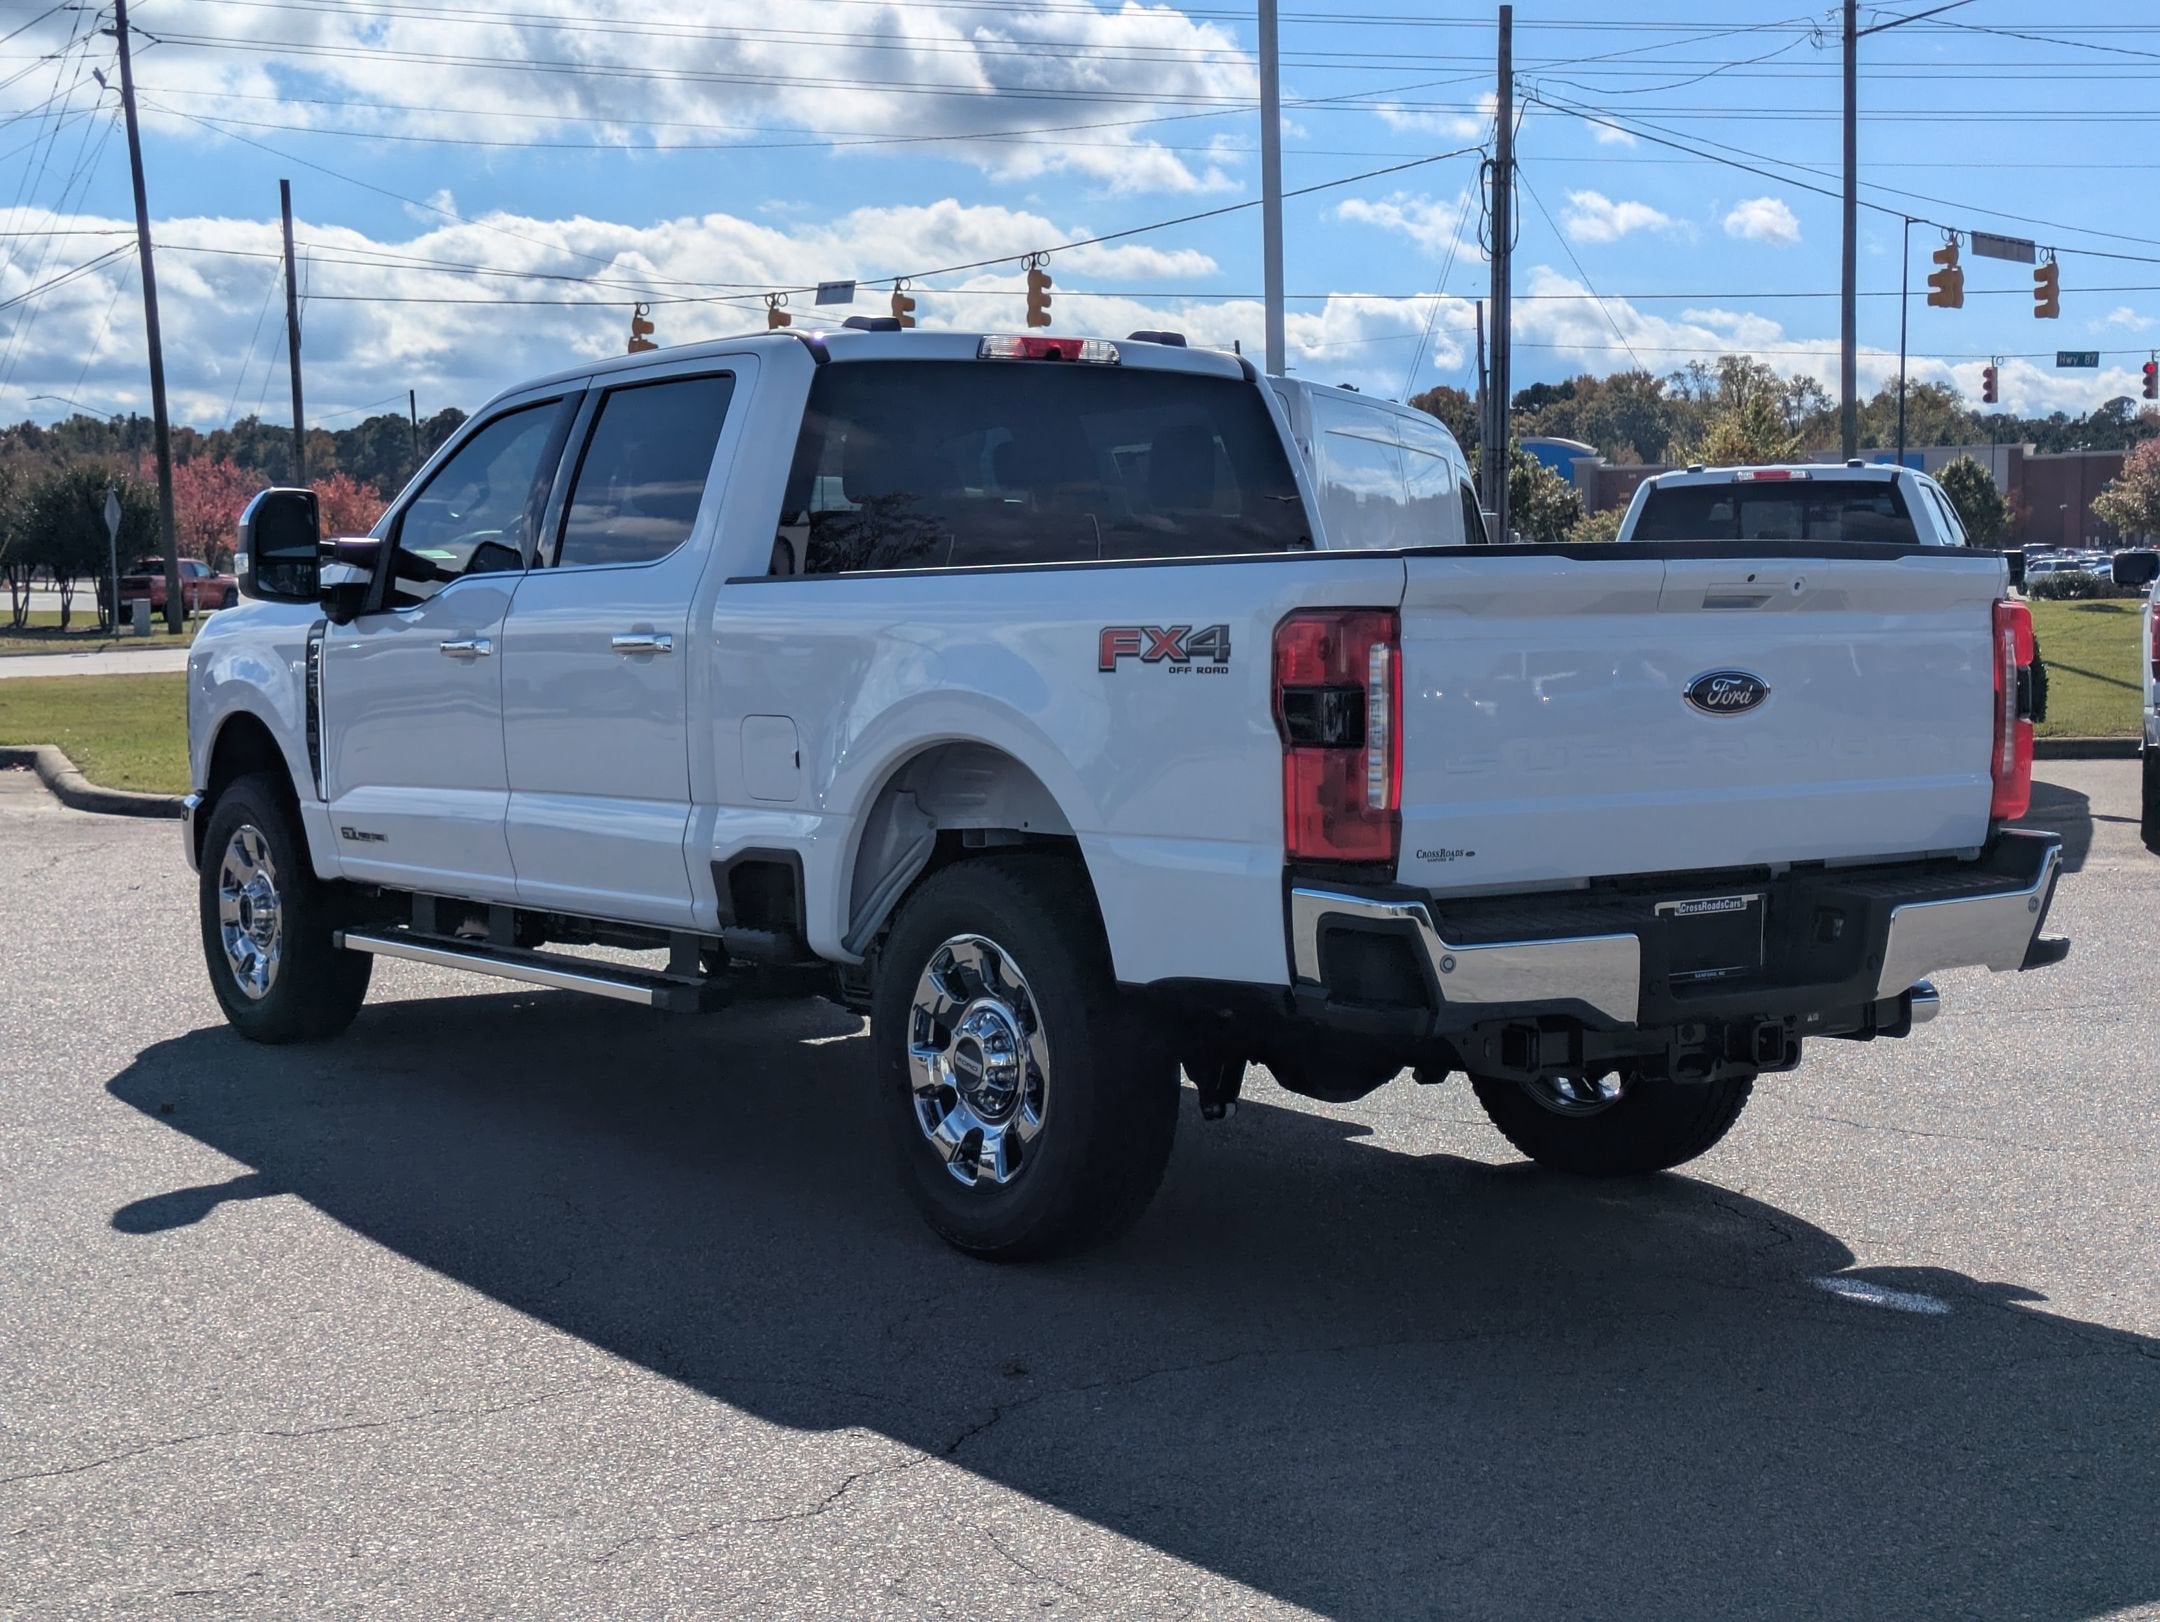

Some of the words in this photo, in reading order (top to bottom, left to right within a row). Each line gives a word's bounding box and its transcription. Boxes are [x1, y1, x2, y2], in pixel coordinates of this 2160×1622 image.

[2059, 353, 2079, 366] Hwy
[2084, 354, 2096, 365] 87
[1098, 624, 1231, 672] FX4
[1169, 666, 1192, 674] OFF
[1196, 666, 1229, 674] ROAD
[1707, 678, 1754, 705] Ford
